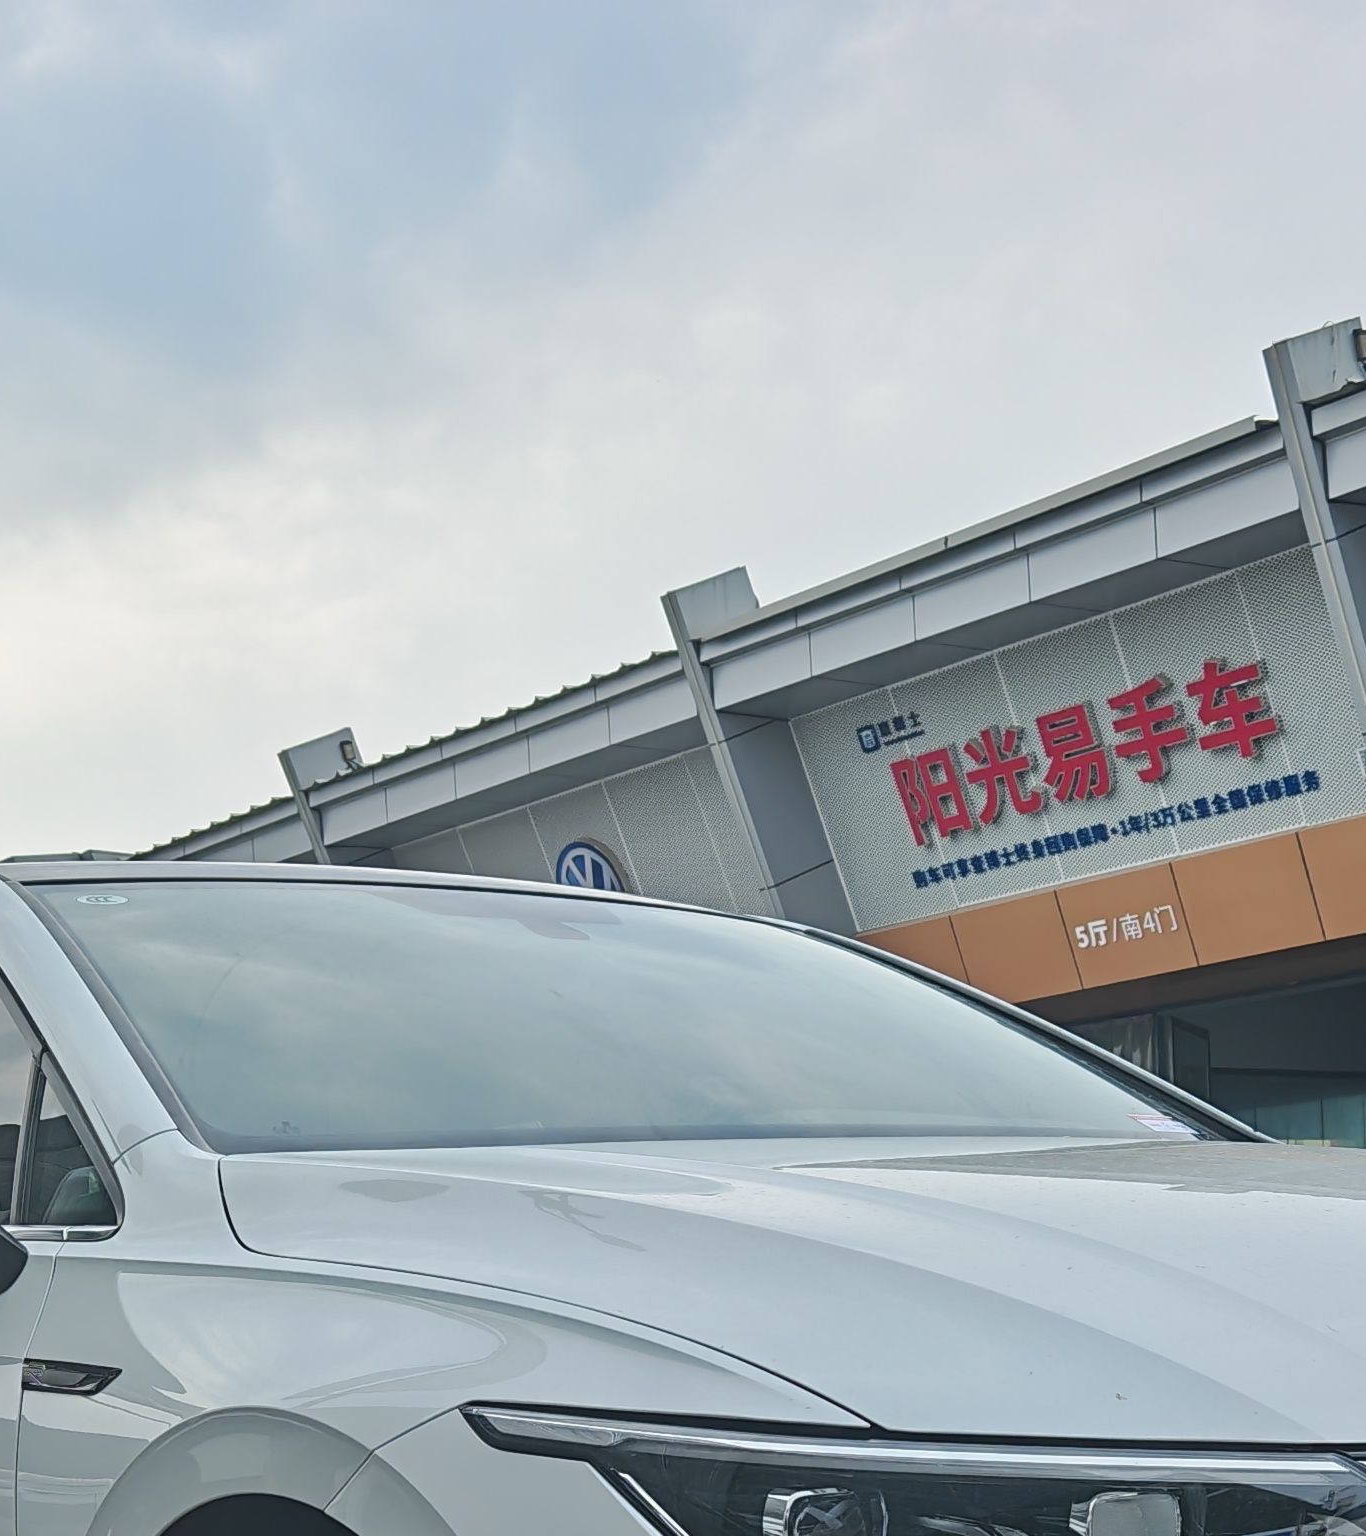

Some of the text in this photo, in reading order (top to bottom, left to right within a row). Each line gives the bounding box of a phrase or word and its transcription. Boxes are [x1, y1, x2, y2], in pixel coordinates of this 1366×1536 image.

[890, 660, 1277, 847] 阳光易手车
[1074, 904, 1178, 949] 5厅/南4门
